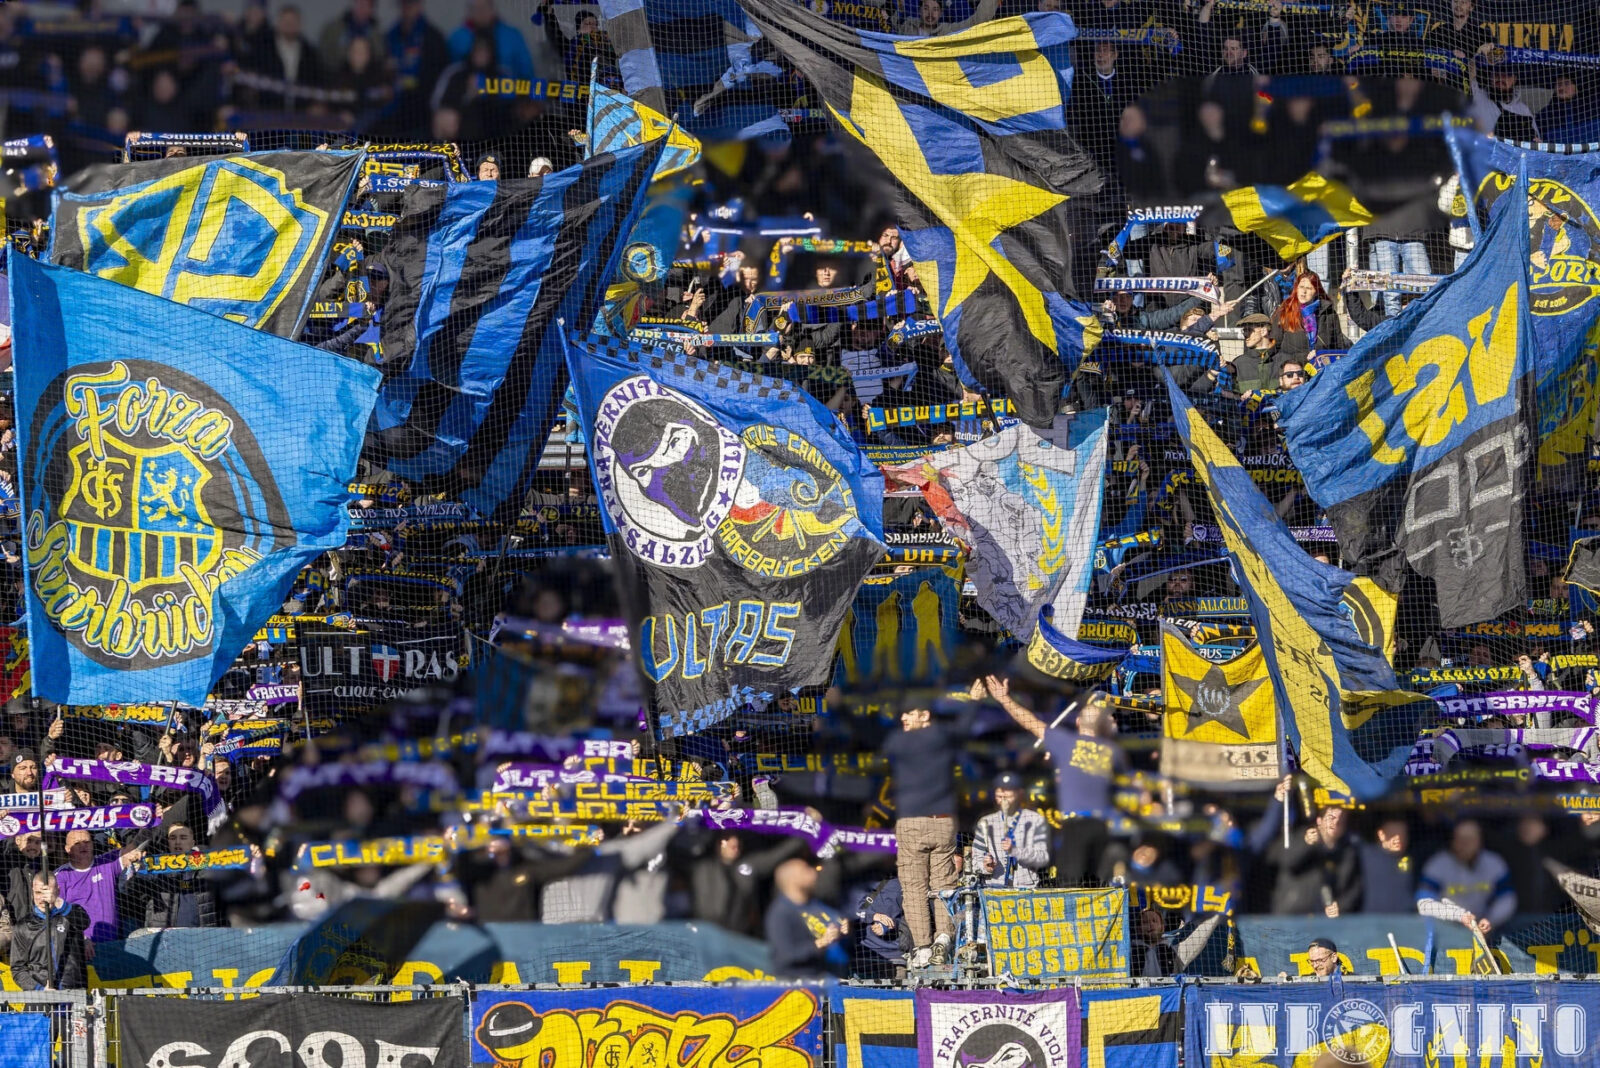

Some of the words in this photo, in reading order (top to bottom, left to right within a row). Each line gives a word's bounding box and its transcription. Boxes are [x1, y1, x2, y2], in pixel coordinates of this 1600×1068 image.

[478, 77, 589, 101] UDWIGSP
[65, 361, 234, 461] Forza
[576, 782, 714, 801] CLIQUE
[26, 807, 122, 830] ULTRAS
[527, 802, 660, 821] CLIQUE
[1076, 890, 1124, 919] DEN
[990, 918, 1124, 950] MODERNEN
[994, 945, 1127, 976] FUSSBALL
[937, 1005, 1036, 1061] FRATERNITÉ
